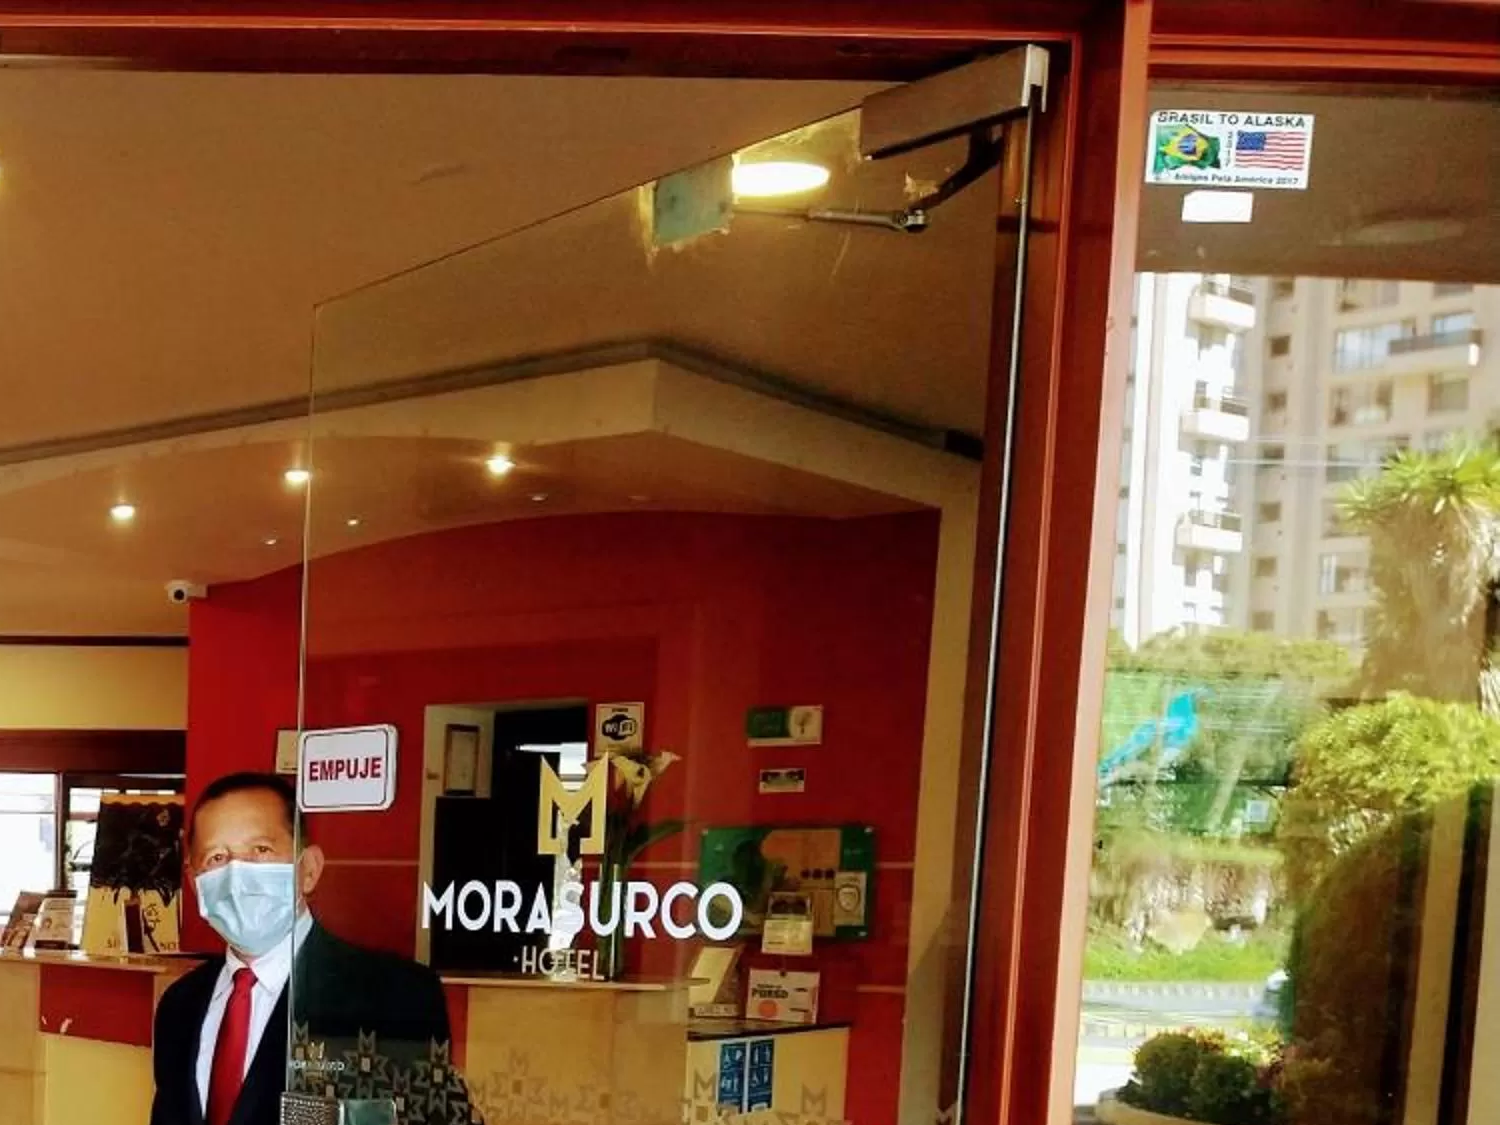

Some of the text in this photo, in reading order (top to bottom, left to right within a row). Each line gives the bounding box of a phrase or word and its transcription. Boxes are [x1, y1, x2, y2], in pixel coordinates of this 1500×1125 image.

[1157, 111, 1305, 128] BRASIL TO ALASKA
[308, 756, 383, 783] EMPUJE
[421, 880, 744, 941] MORASURCO
